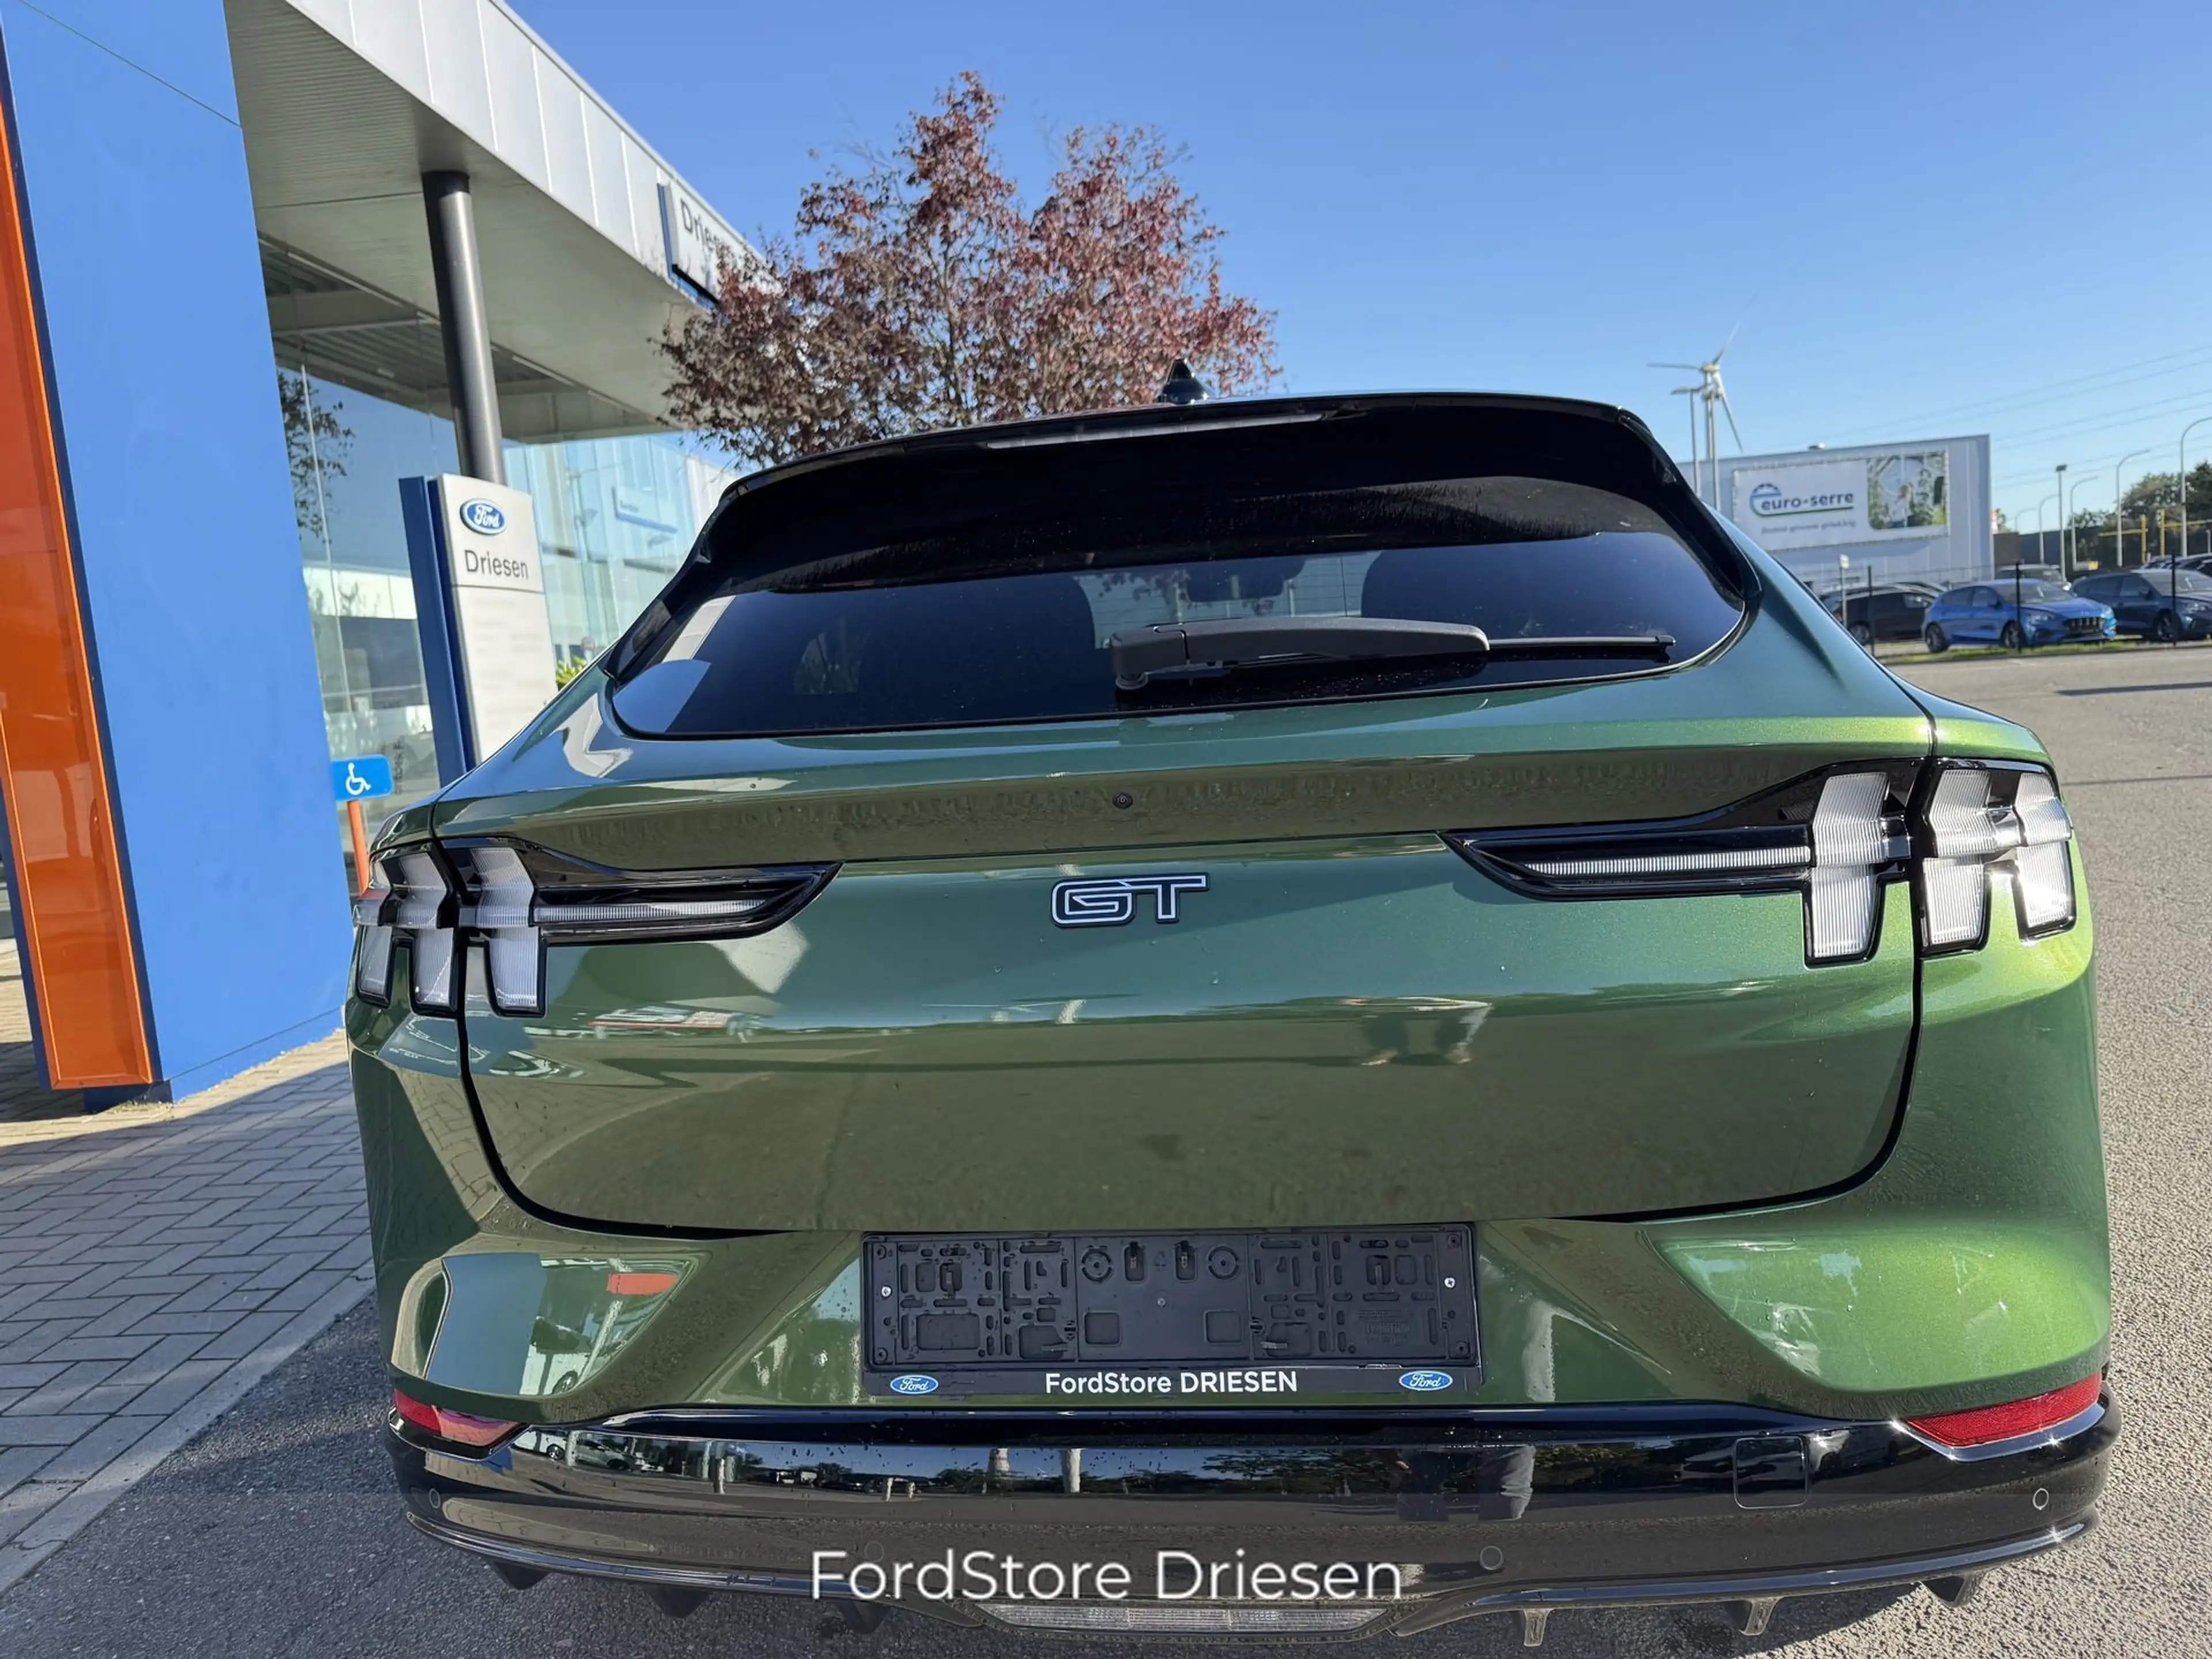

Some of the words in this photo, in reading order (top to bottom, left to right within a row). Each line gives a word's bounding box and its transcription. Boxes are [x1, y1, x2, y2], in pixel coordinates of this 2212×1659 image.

[474, 505, 501, 528] Ford
[464, 549, 529, 579] Driesen
[1051, 873, 1209, 928] GT
[900, 1377, 929, 1391] Ford
[1046, 1372, 1171, 1393] FordStore
[1180, 1370, 1297, 1392] DRIESEN
[1410, 1374, 1441, 1387] Ford
